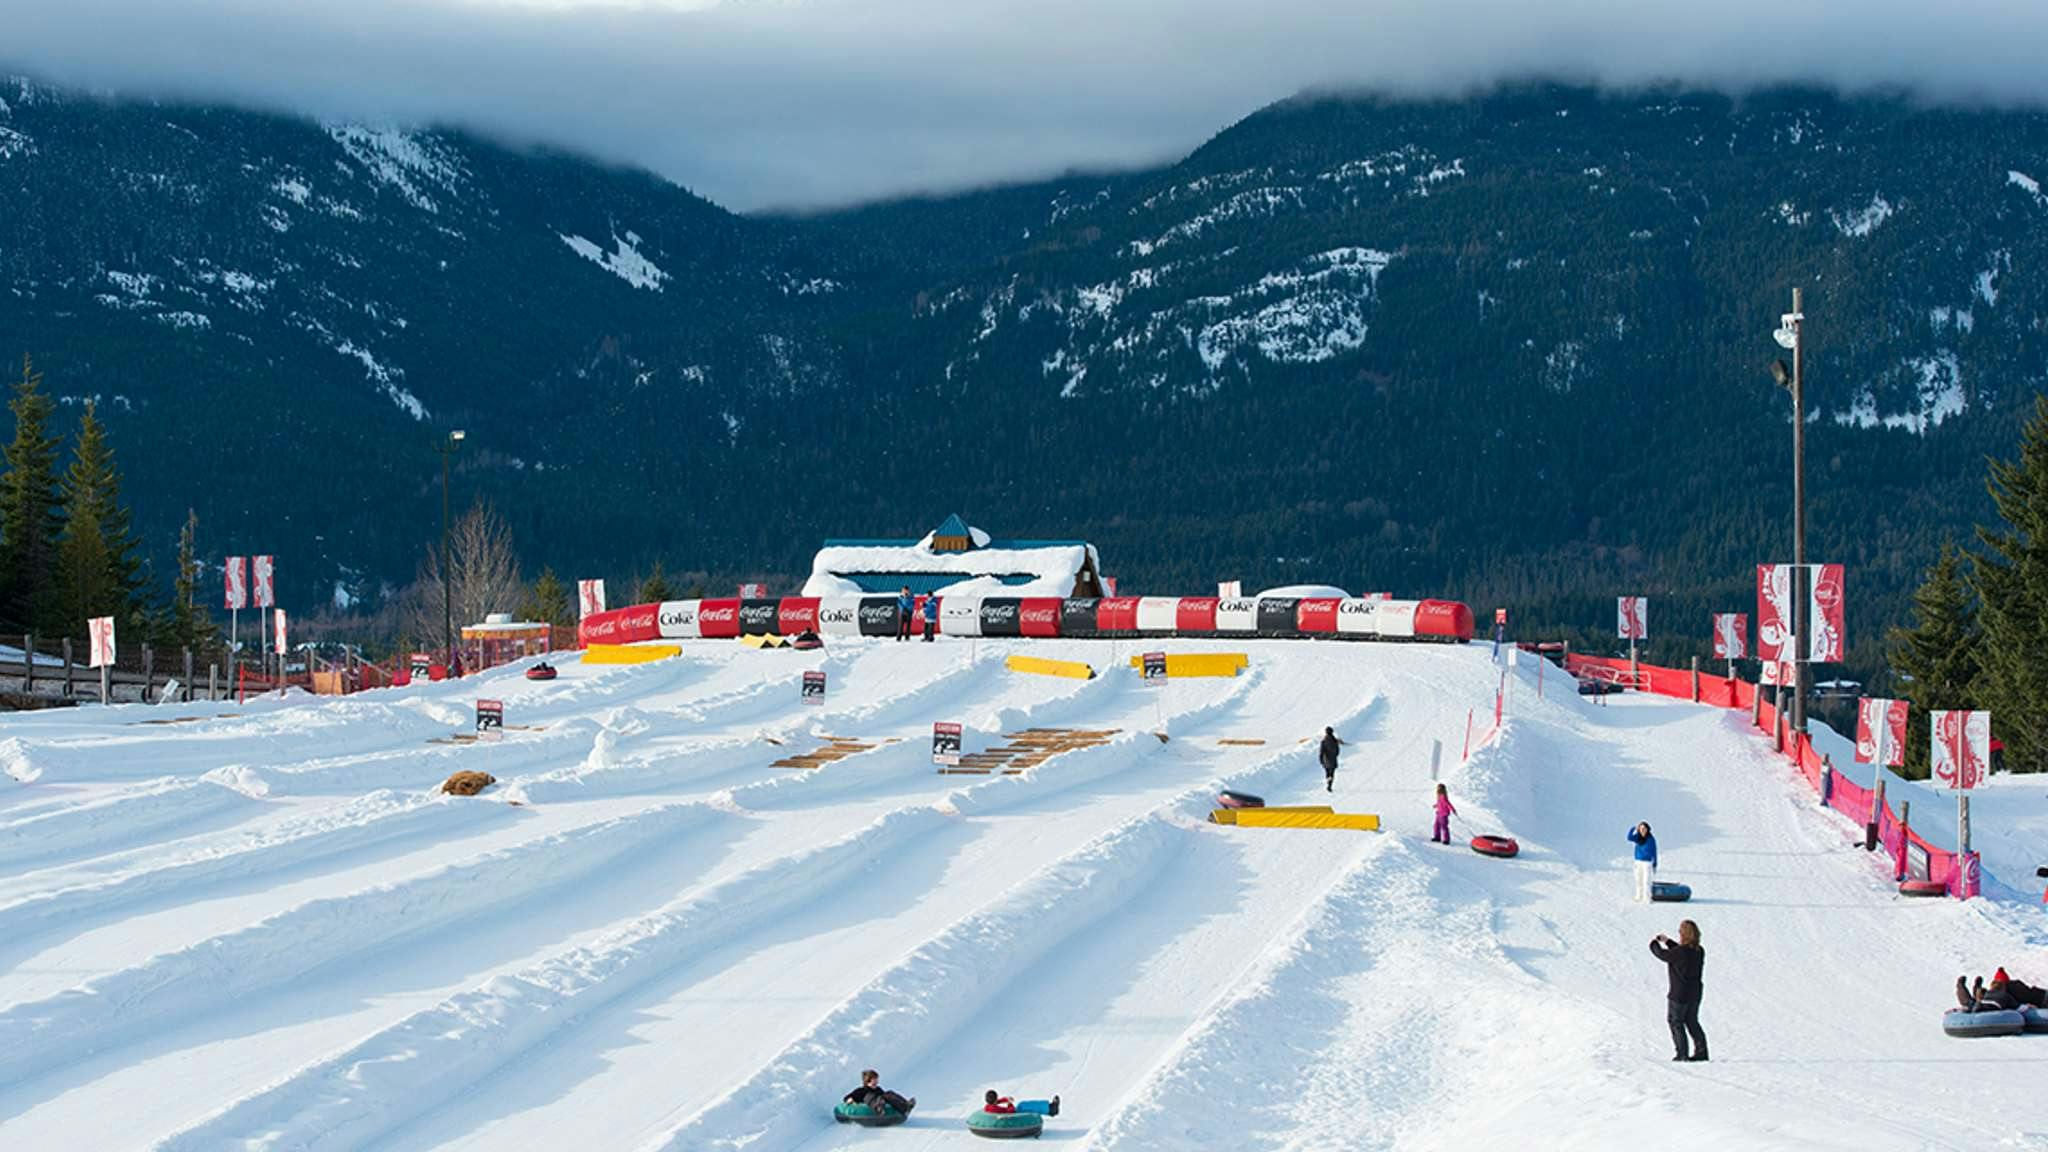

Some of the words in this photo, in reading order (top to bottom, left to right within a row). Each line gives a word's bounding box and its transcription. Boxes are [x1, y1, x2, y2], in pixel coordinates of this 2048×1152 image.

[1219, 600, 1253, 612] Coke
[1340, 602, 1375, 614] Coke
[660, 612, 693, 625] Coke
[820, 608, 853, 623] Coke
